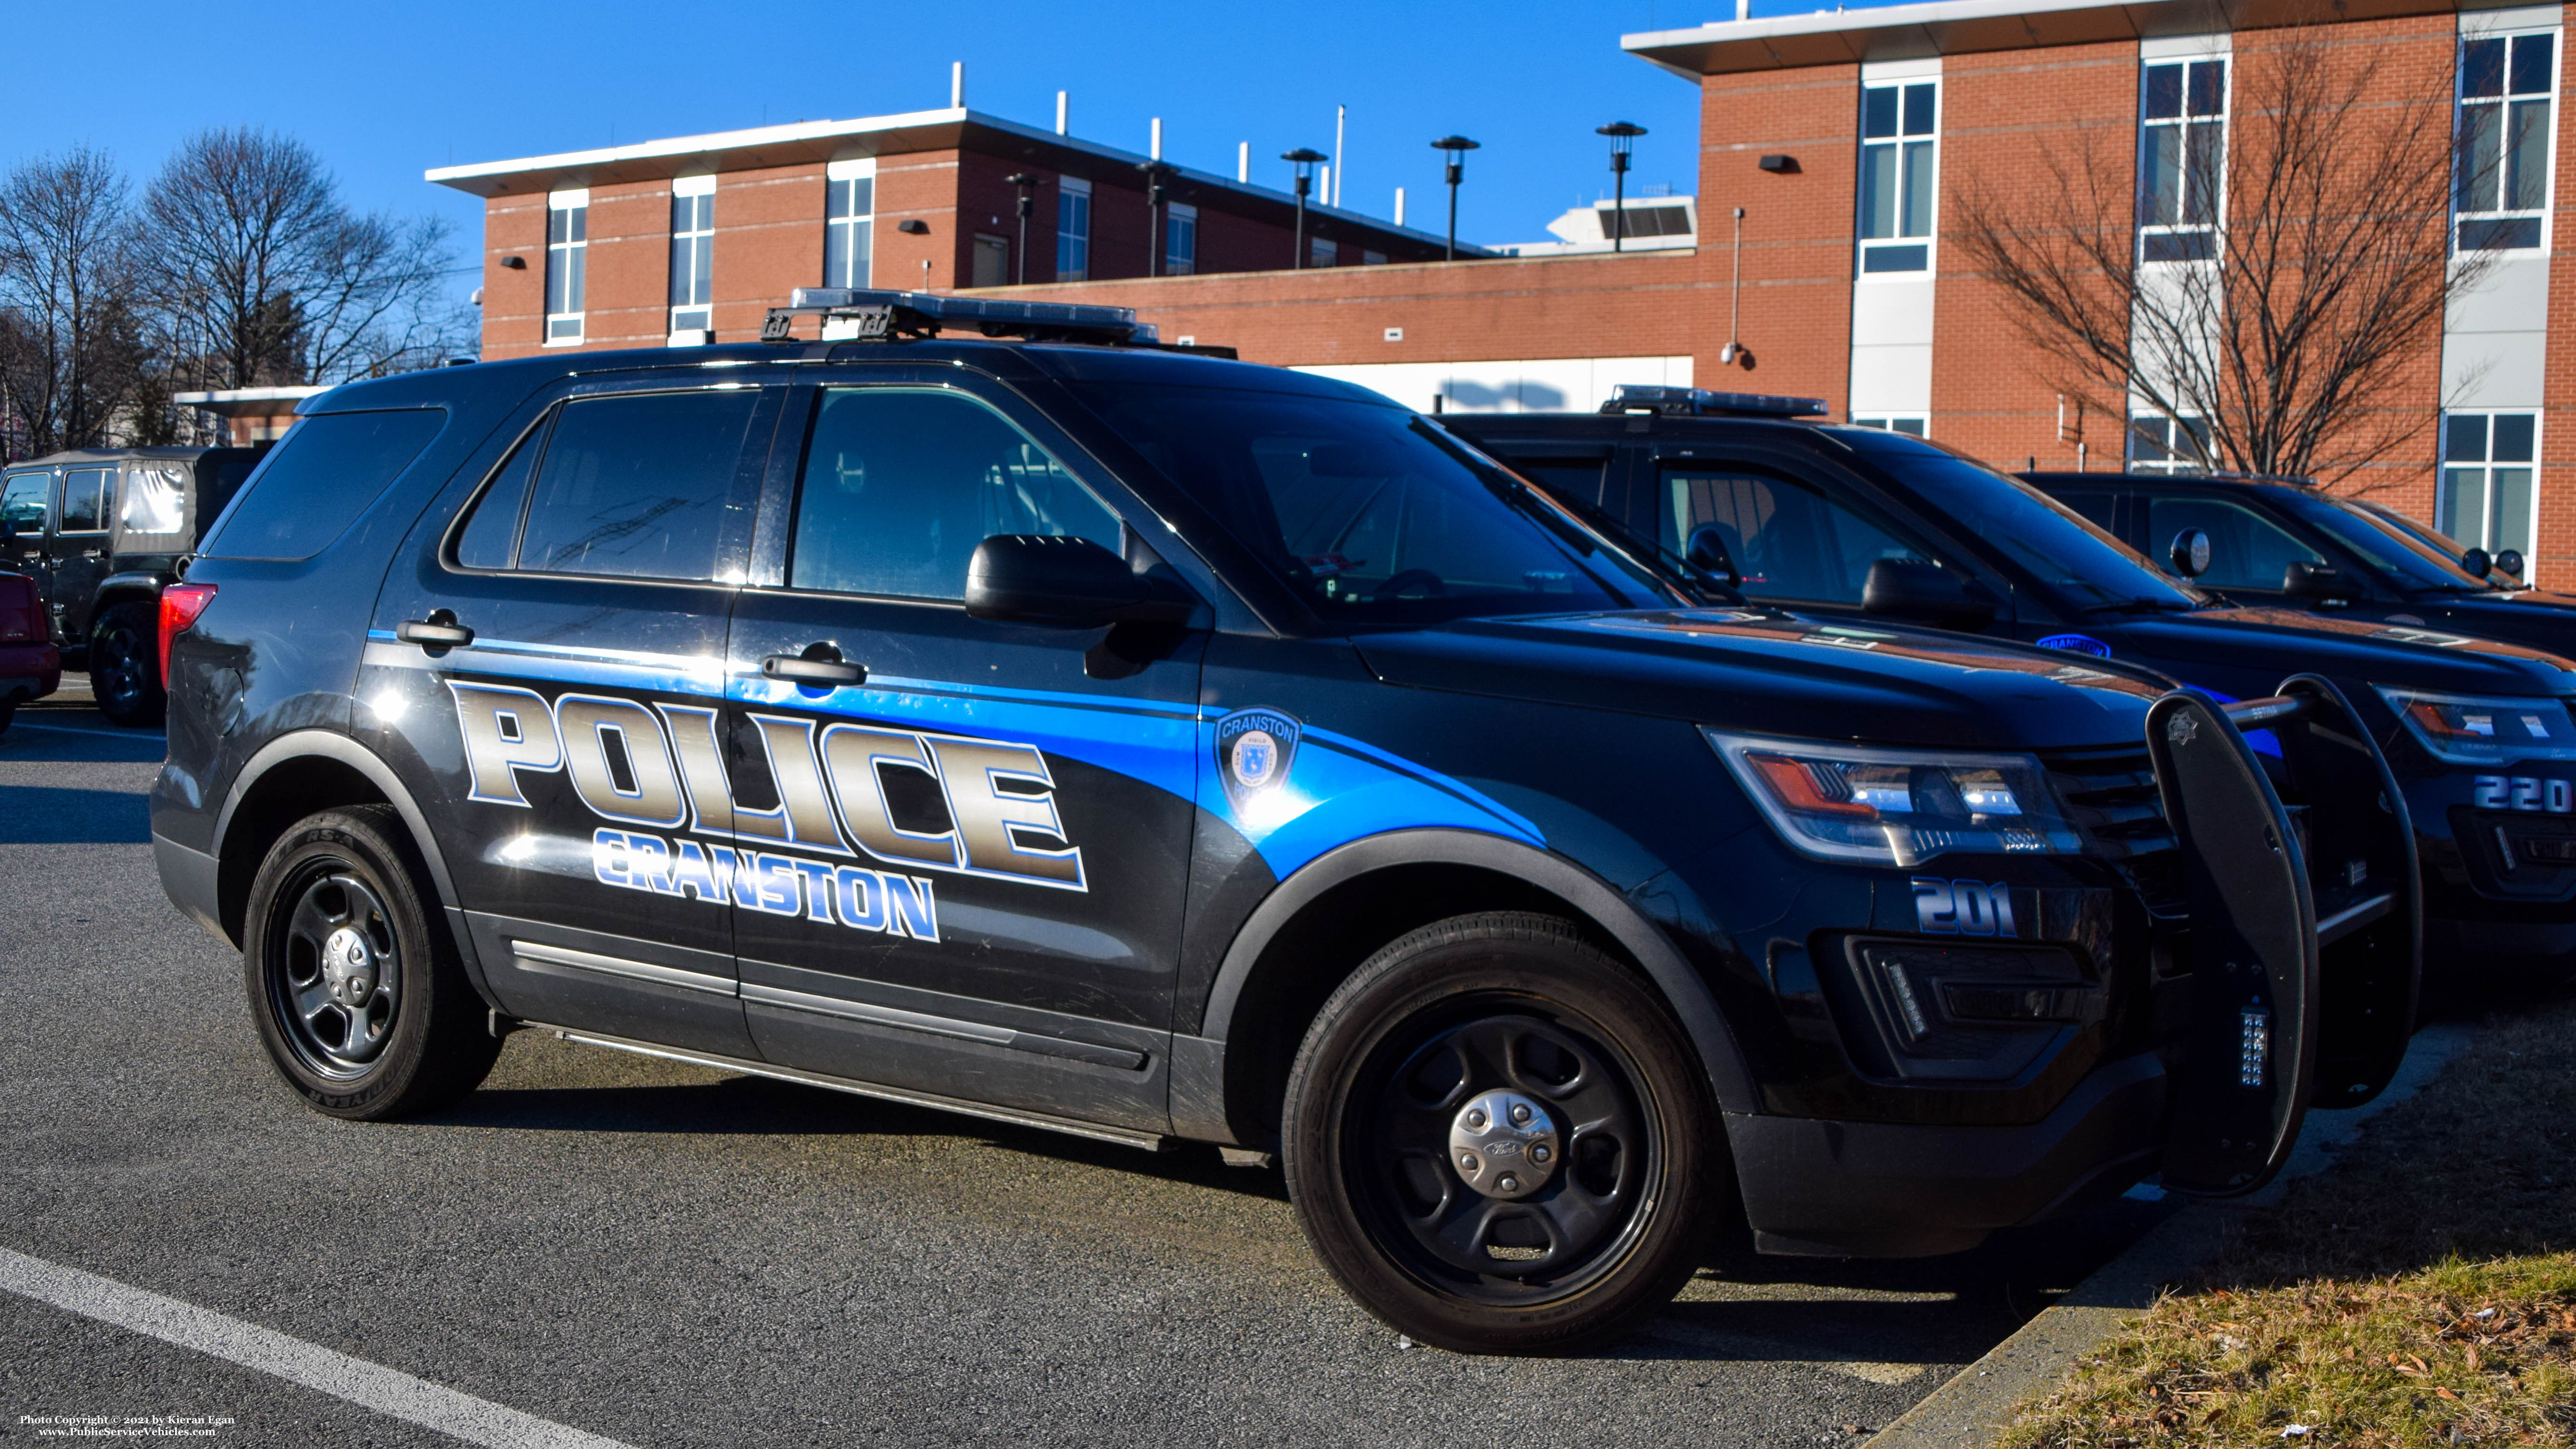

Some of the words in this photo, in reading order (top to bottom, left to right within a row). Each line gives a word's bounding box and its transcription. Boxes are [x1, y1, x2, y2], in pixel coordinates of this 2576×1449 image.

[1222, 716, 1293, 743] CRANSTON
[446, 679, 1088, 892] POLICE
[2474, 774, 2573, 813] 220
[592, 827, 939, 942] CRANSTON
[1910, 876, 2018, 937] 201
